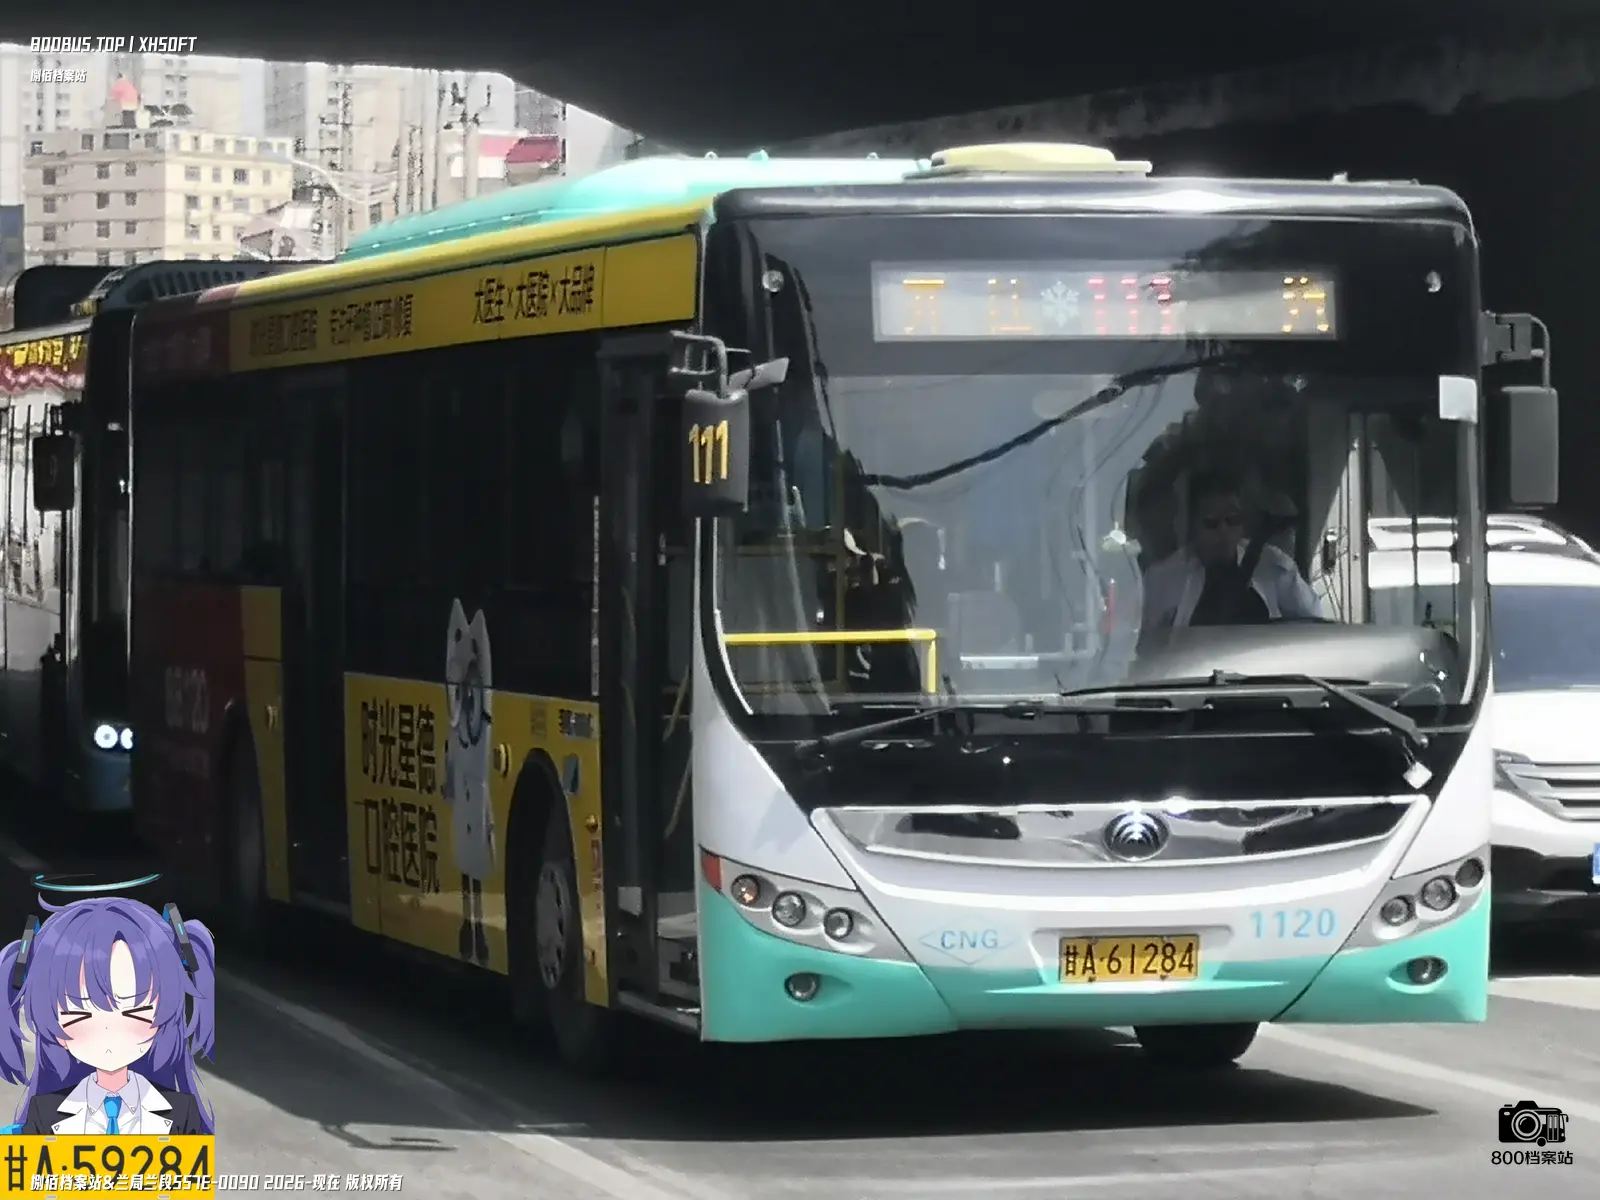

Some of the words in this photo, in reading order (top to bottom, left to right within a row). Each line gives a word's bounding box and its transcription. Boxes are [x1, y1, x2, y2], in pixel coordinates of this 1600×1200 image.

[687, 419, 729, 485] 111
[363, 796, 440, 894] 口腔医院
[940, 929, 999, 950] CNG
[1250, 908, 1337, 939] 1120
